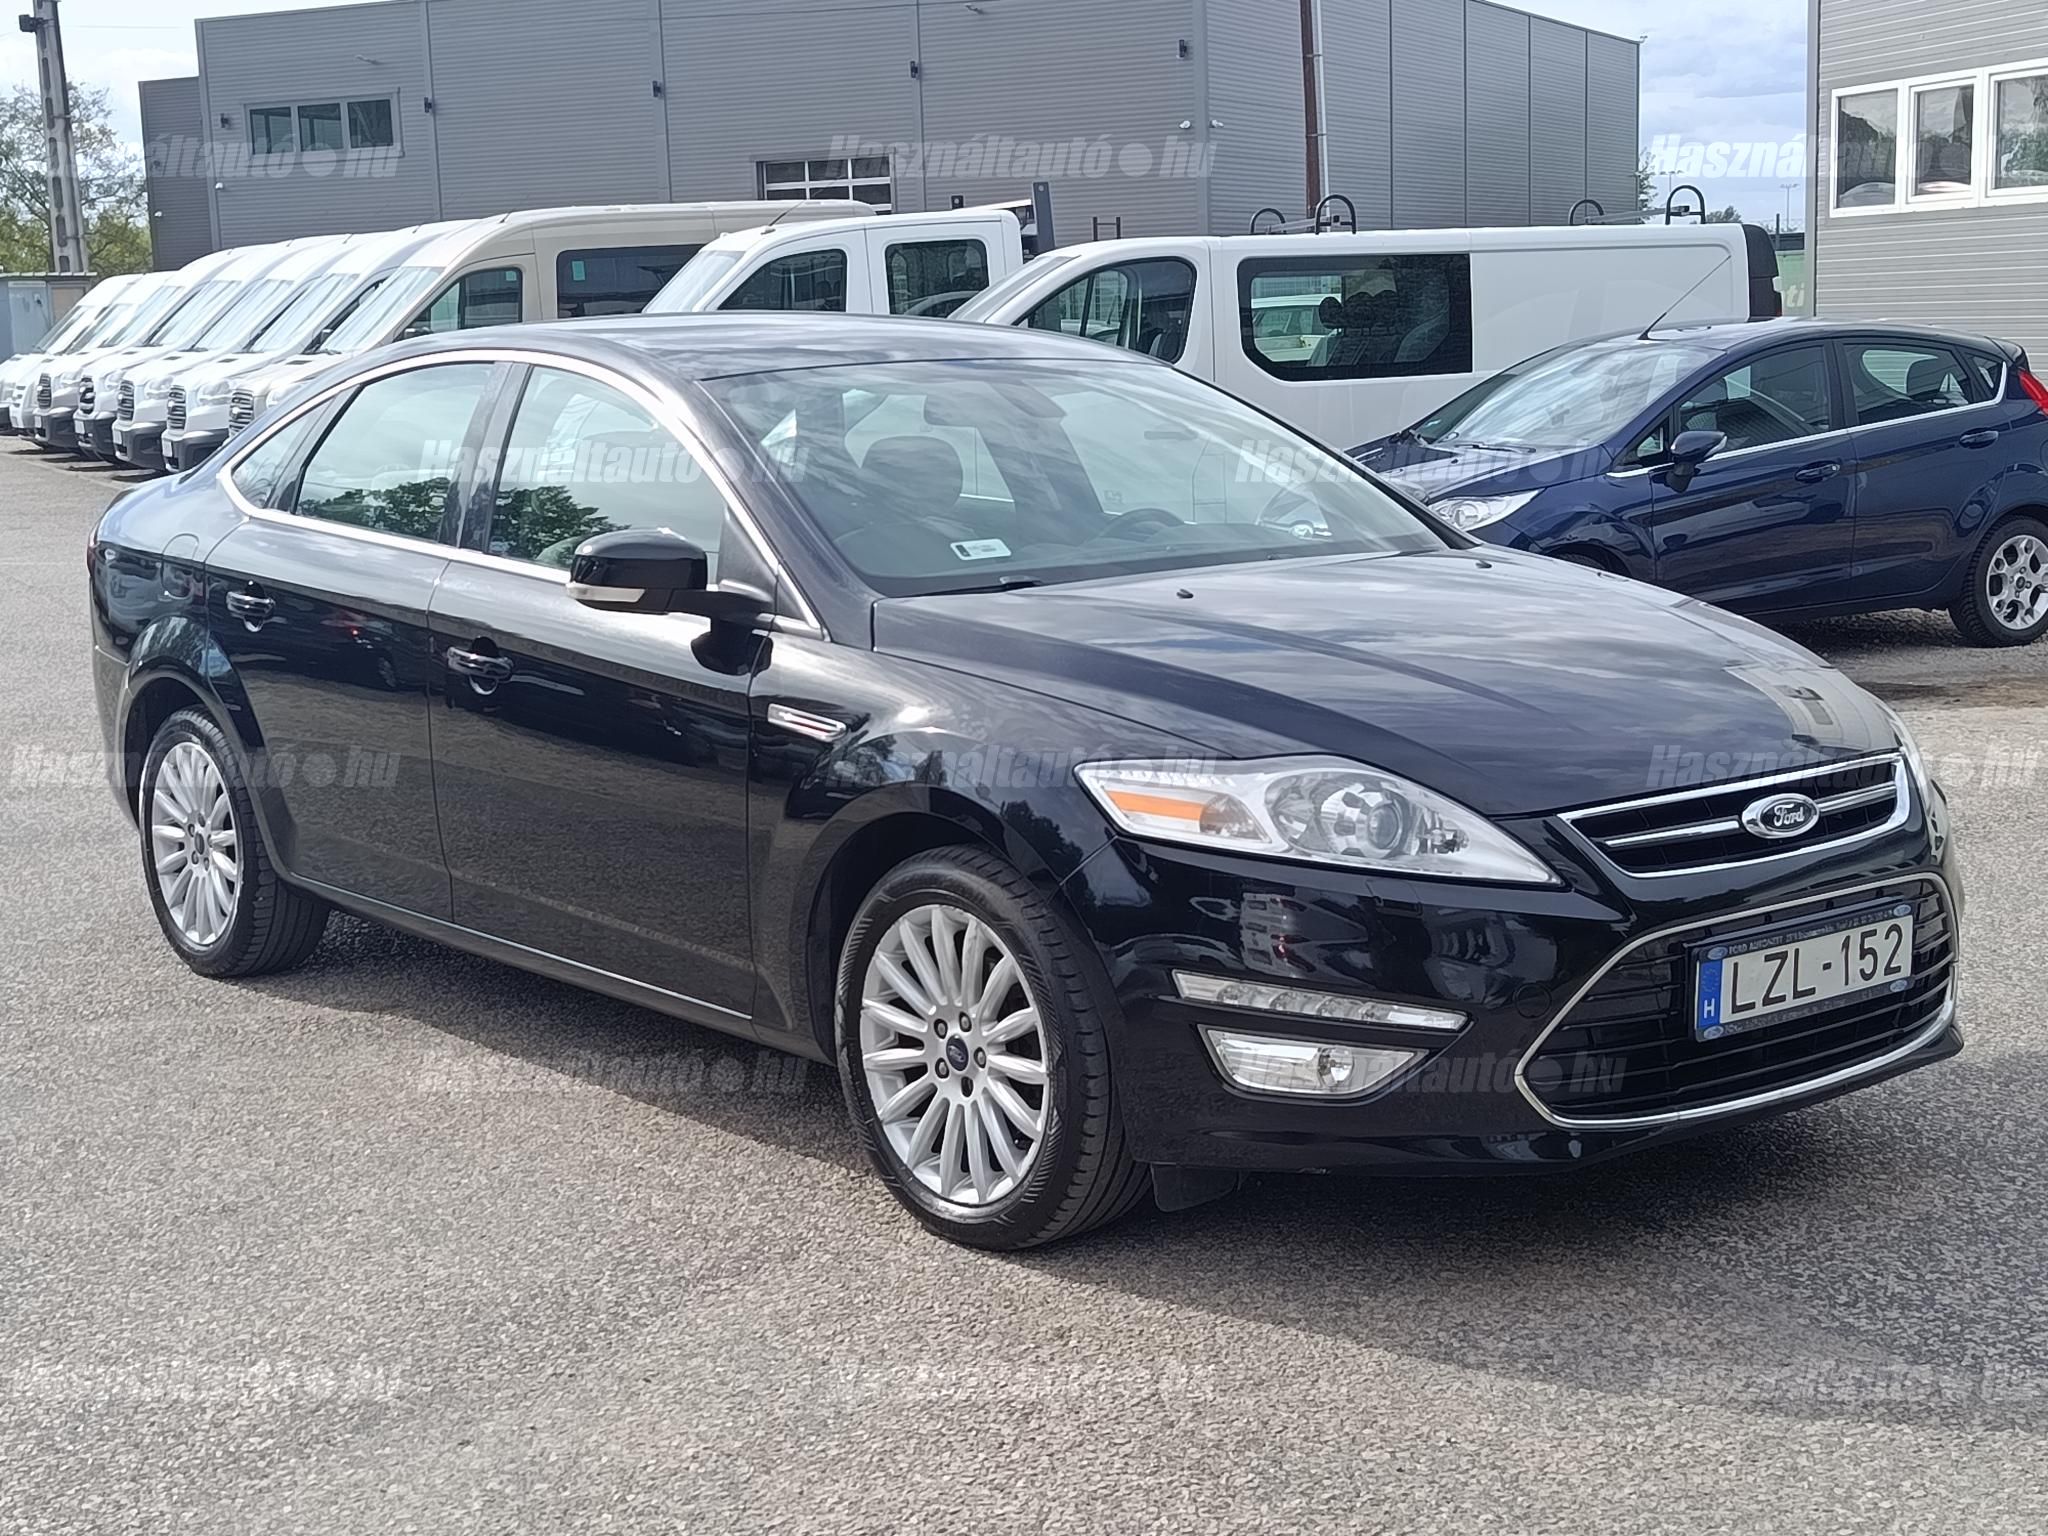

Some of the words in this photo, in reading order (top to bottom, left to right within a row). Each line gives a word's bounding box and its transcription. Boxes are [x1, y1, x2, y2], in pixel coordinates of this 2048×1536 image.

[1774, 803, 1804, 827] Ford
[1731, 923, 1903, 1014] LZL-152
[1703, 998, 1715, 1018] H
